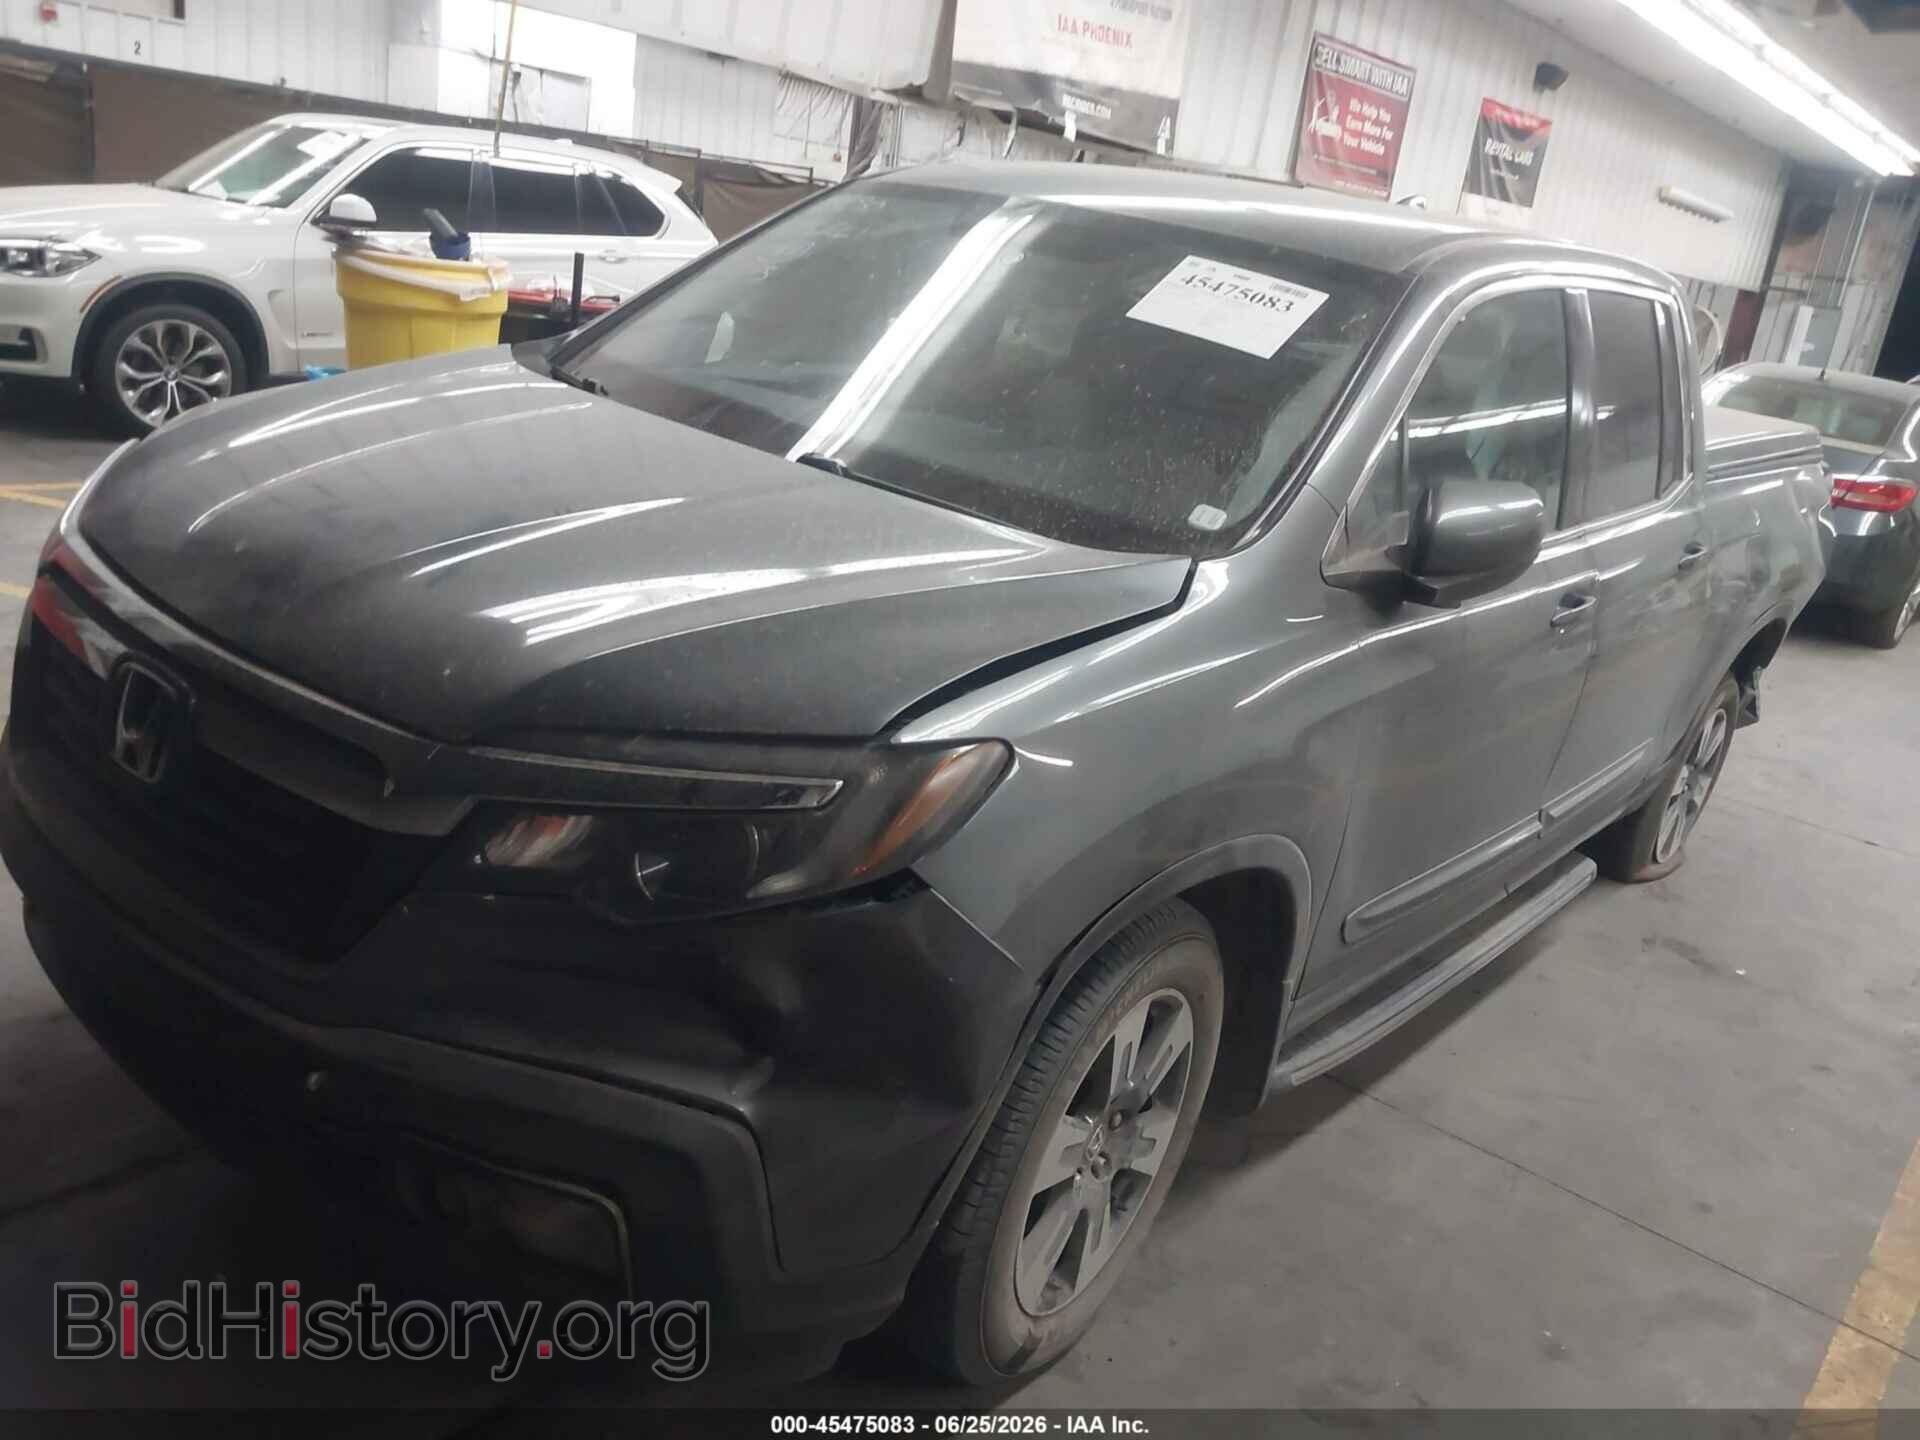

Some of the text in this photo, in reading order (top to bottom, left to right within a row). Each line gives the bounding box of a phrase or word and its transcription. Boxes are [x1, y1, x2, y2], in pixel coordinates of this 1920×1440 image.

[1056, 15, 1133, 48] IAA PHOENIX
[133, 40, 141, 55] 2
[1362, 119, 1380, 137] More
[1381, 125, 1394, 141] For
[1360, 137, 1385, 156] Vehicle
[1181, 273, 1294, 312] 45475083
